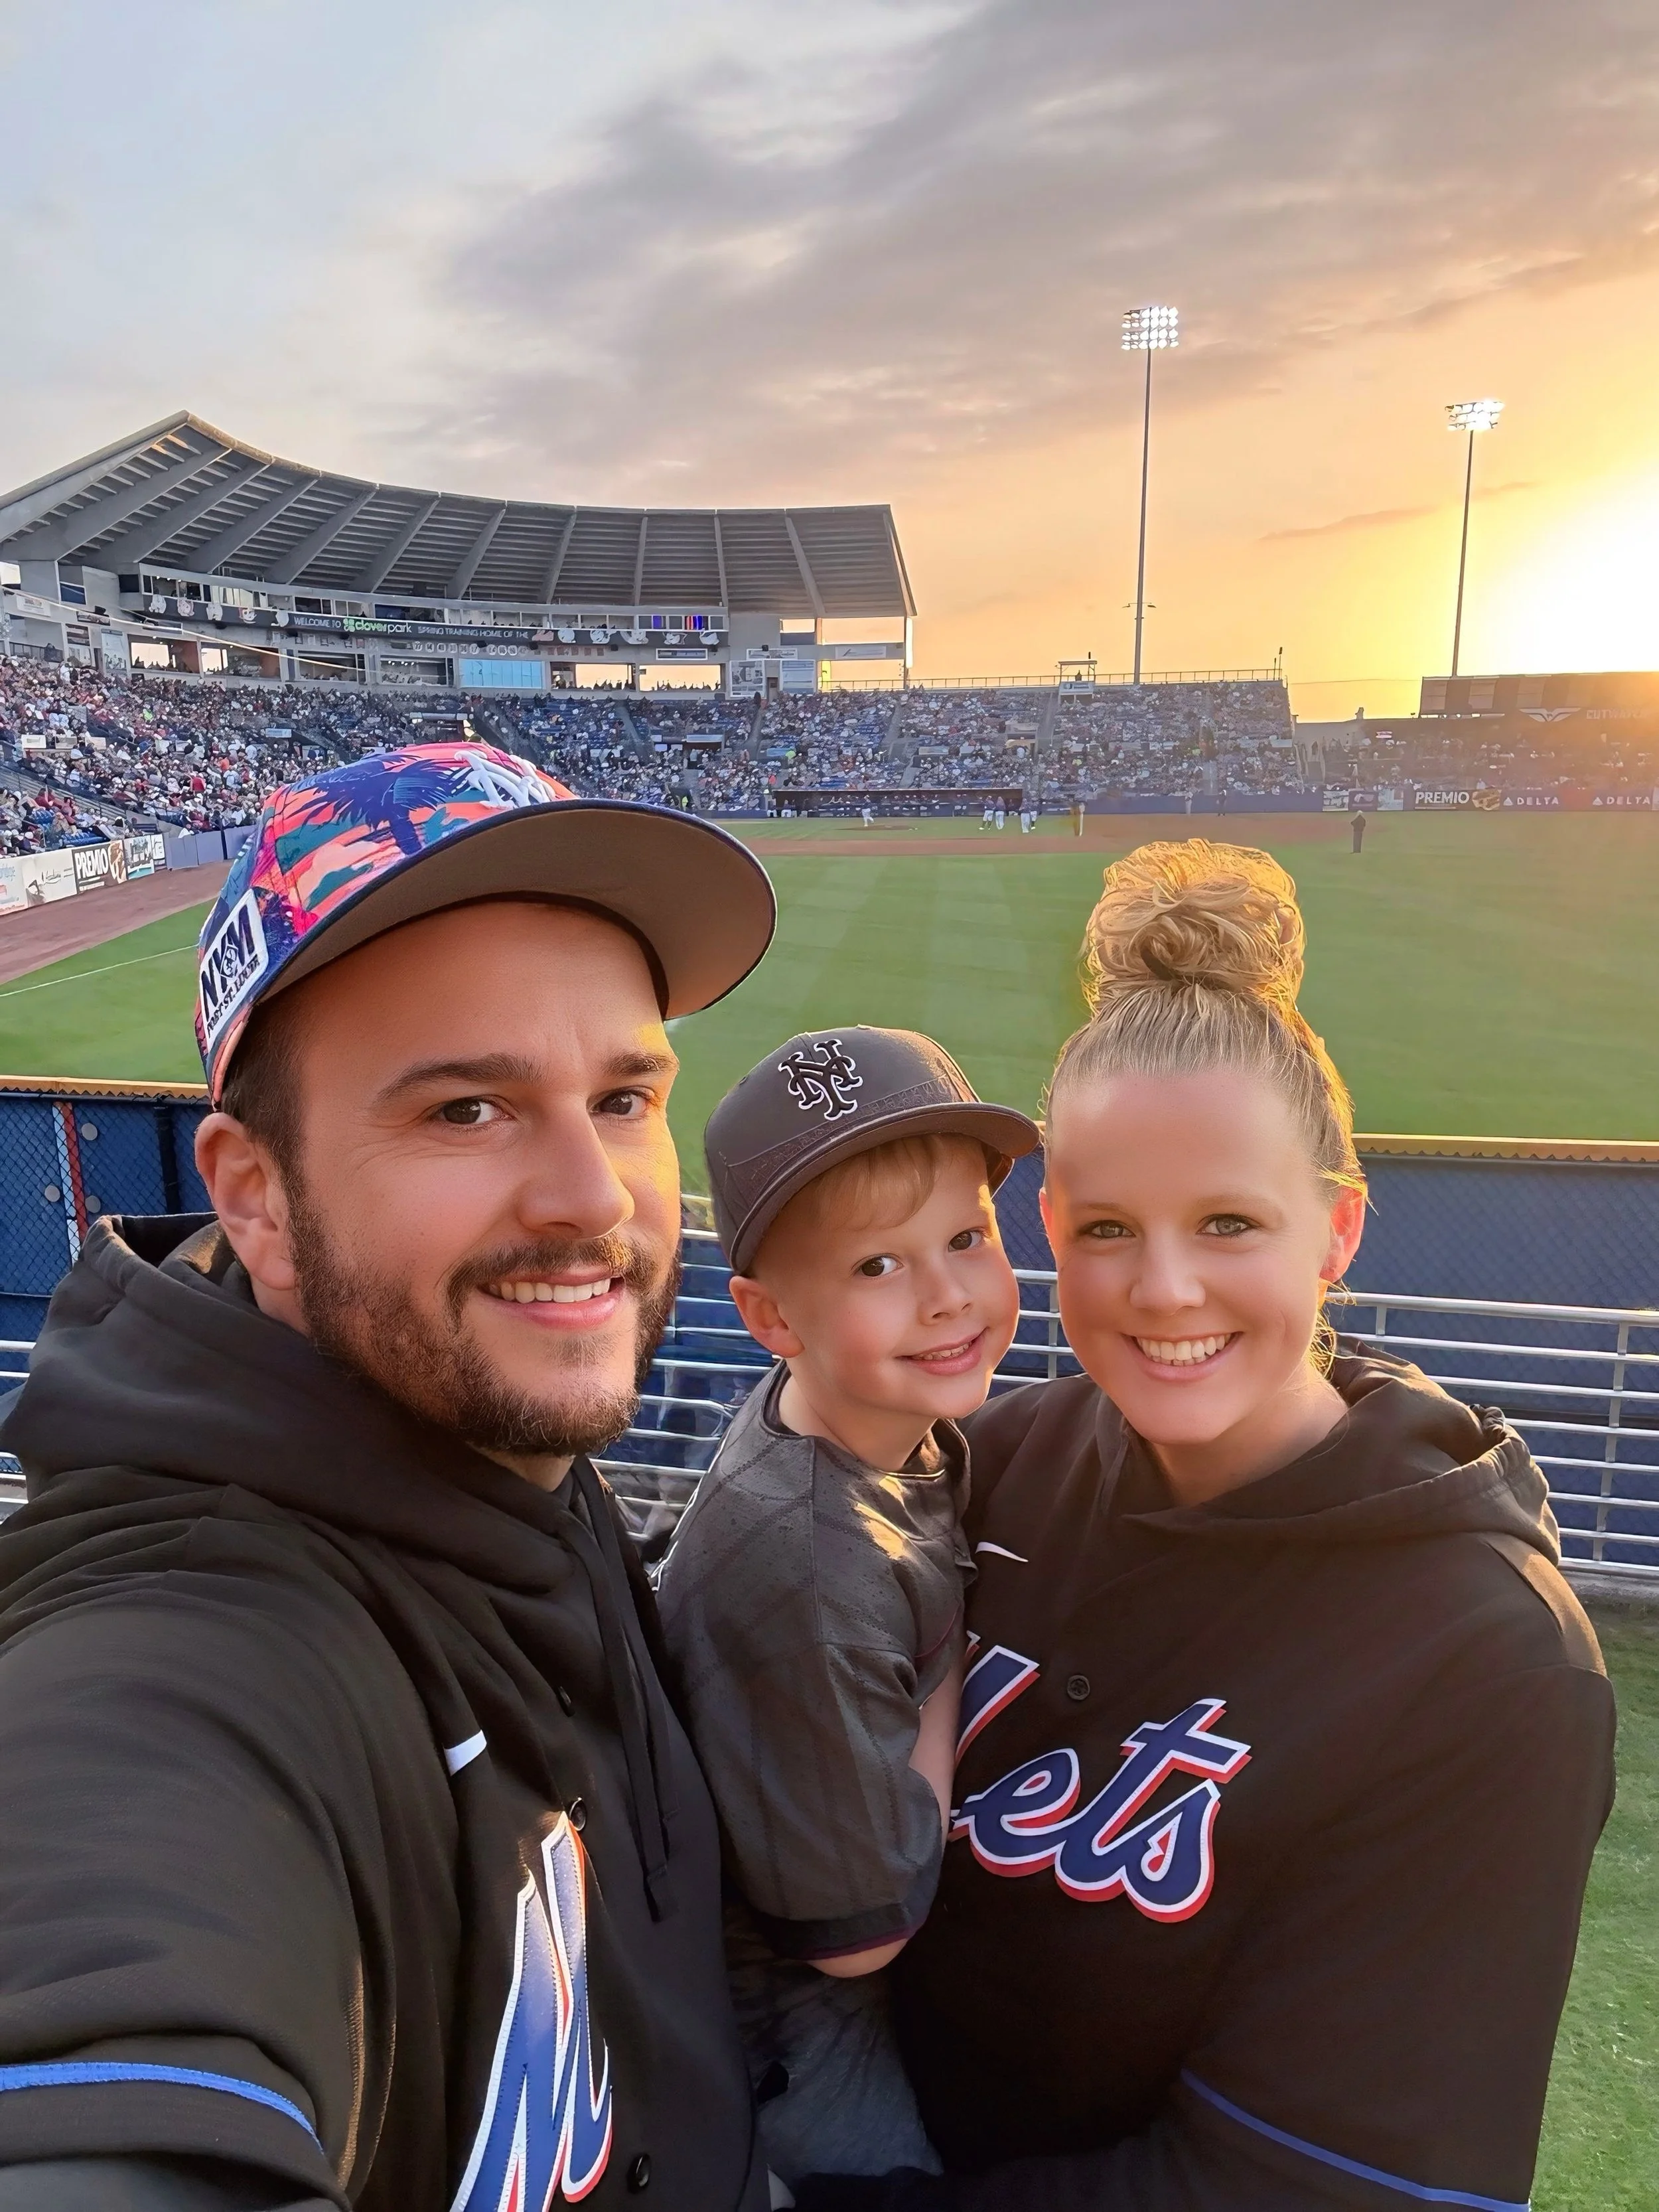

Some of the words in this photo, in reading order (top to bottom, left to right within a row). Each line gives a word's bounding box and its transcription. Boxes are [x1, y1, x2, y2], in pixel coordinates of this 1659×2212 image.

[294, 616, 330, 628] WELCOME
[1415, 791, 1470, 804] PREMIO
[1517, 796, 1559, 805] DELTA
[1606, 796, 1651, 805] DELTA
[74, 848, 109, 879] PREMIO
[201, 904, 255, 1022] NYM
[207, 1002, 224, 1038] PORT
